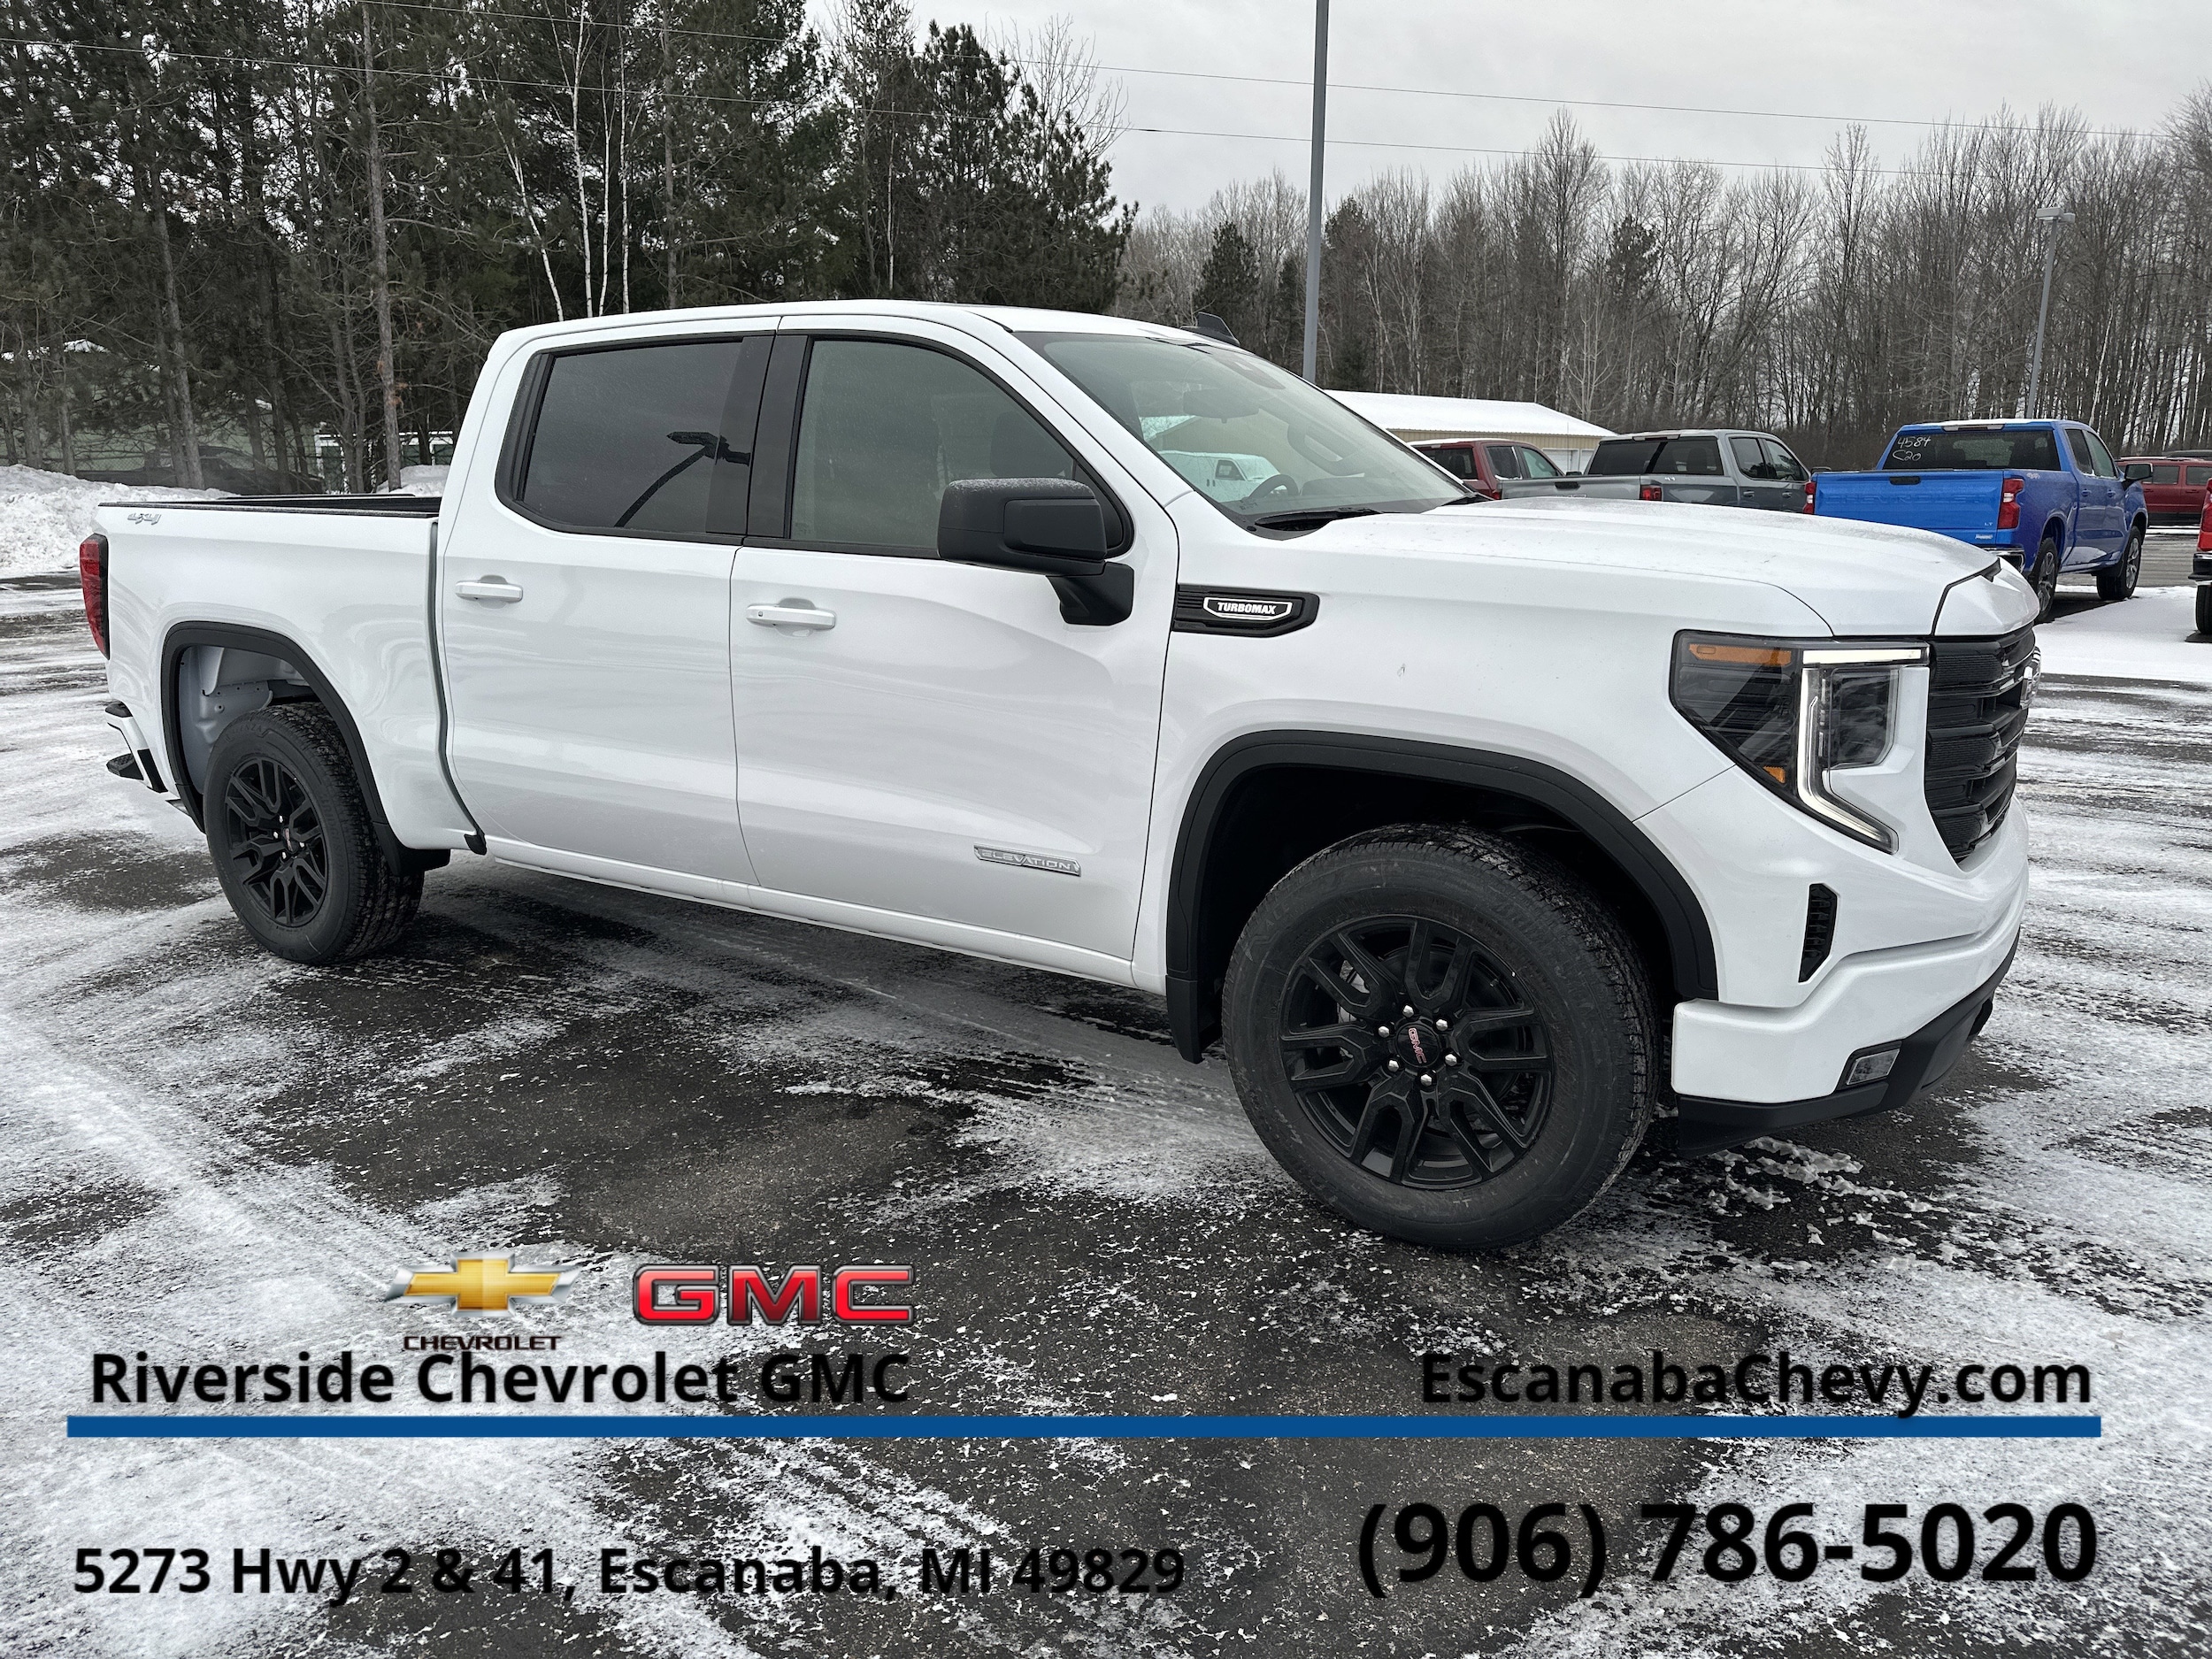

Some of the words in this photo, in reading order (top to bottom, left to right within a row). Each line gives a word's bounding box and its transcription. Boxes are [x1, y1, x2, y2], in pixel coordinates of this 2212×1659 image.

[1897, 436, 1932, 449] 4584
[1217, 602, 1277, 615] TURBOMAX
[981, 849, 1071, 871] ELEVATION
[1408, 1027, 1427, 1064] GMC
